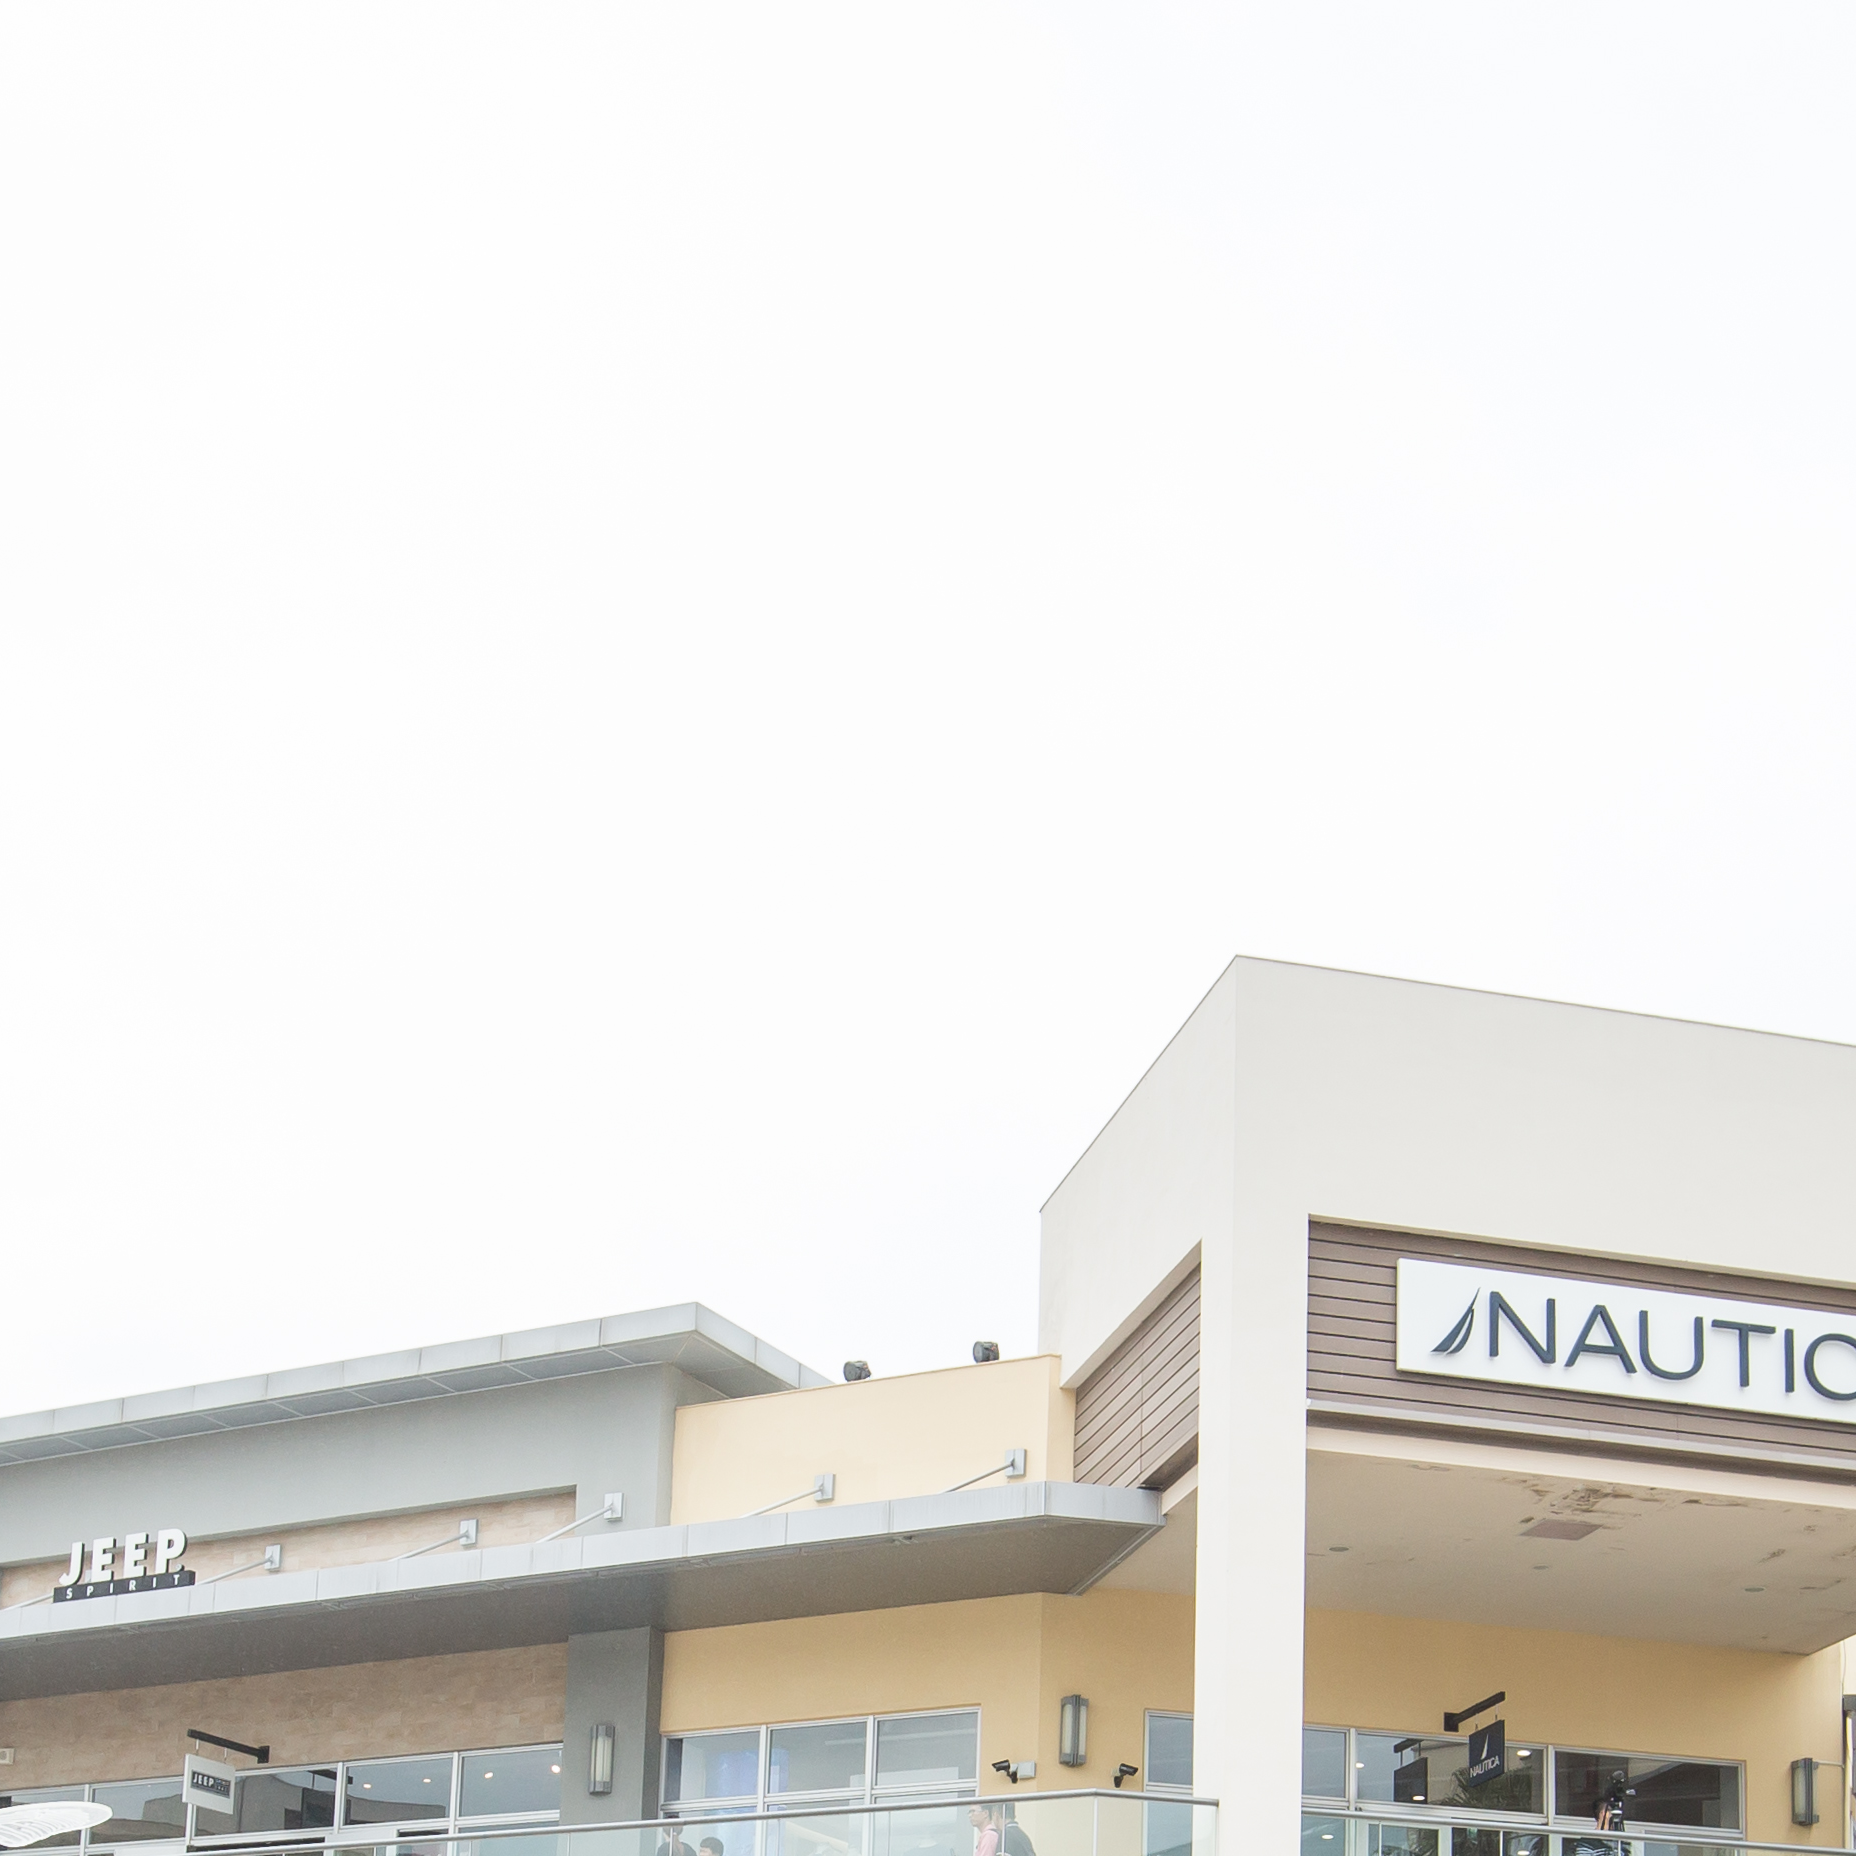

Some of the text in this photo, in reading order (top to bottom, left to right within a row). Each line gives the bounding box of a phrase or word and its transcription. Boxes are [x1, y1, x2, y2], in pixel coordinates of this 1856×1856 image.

[58, 1528, 187, 1586] JEEP
[65, 1573, 181, 1600] SPIRIT
[1470, 1755, 1500, 1778] NAUTICA
[193, 1773, 215, 1787] JEEP
